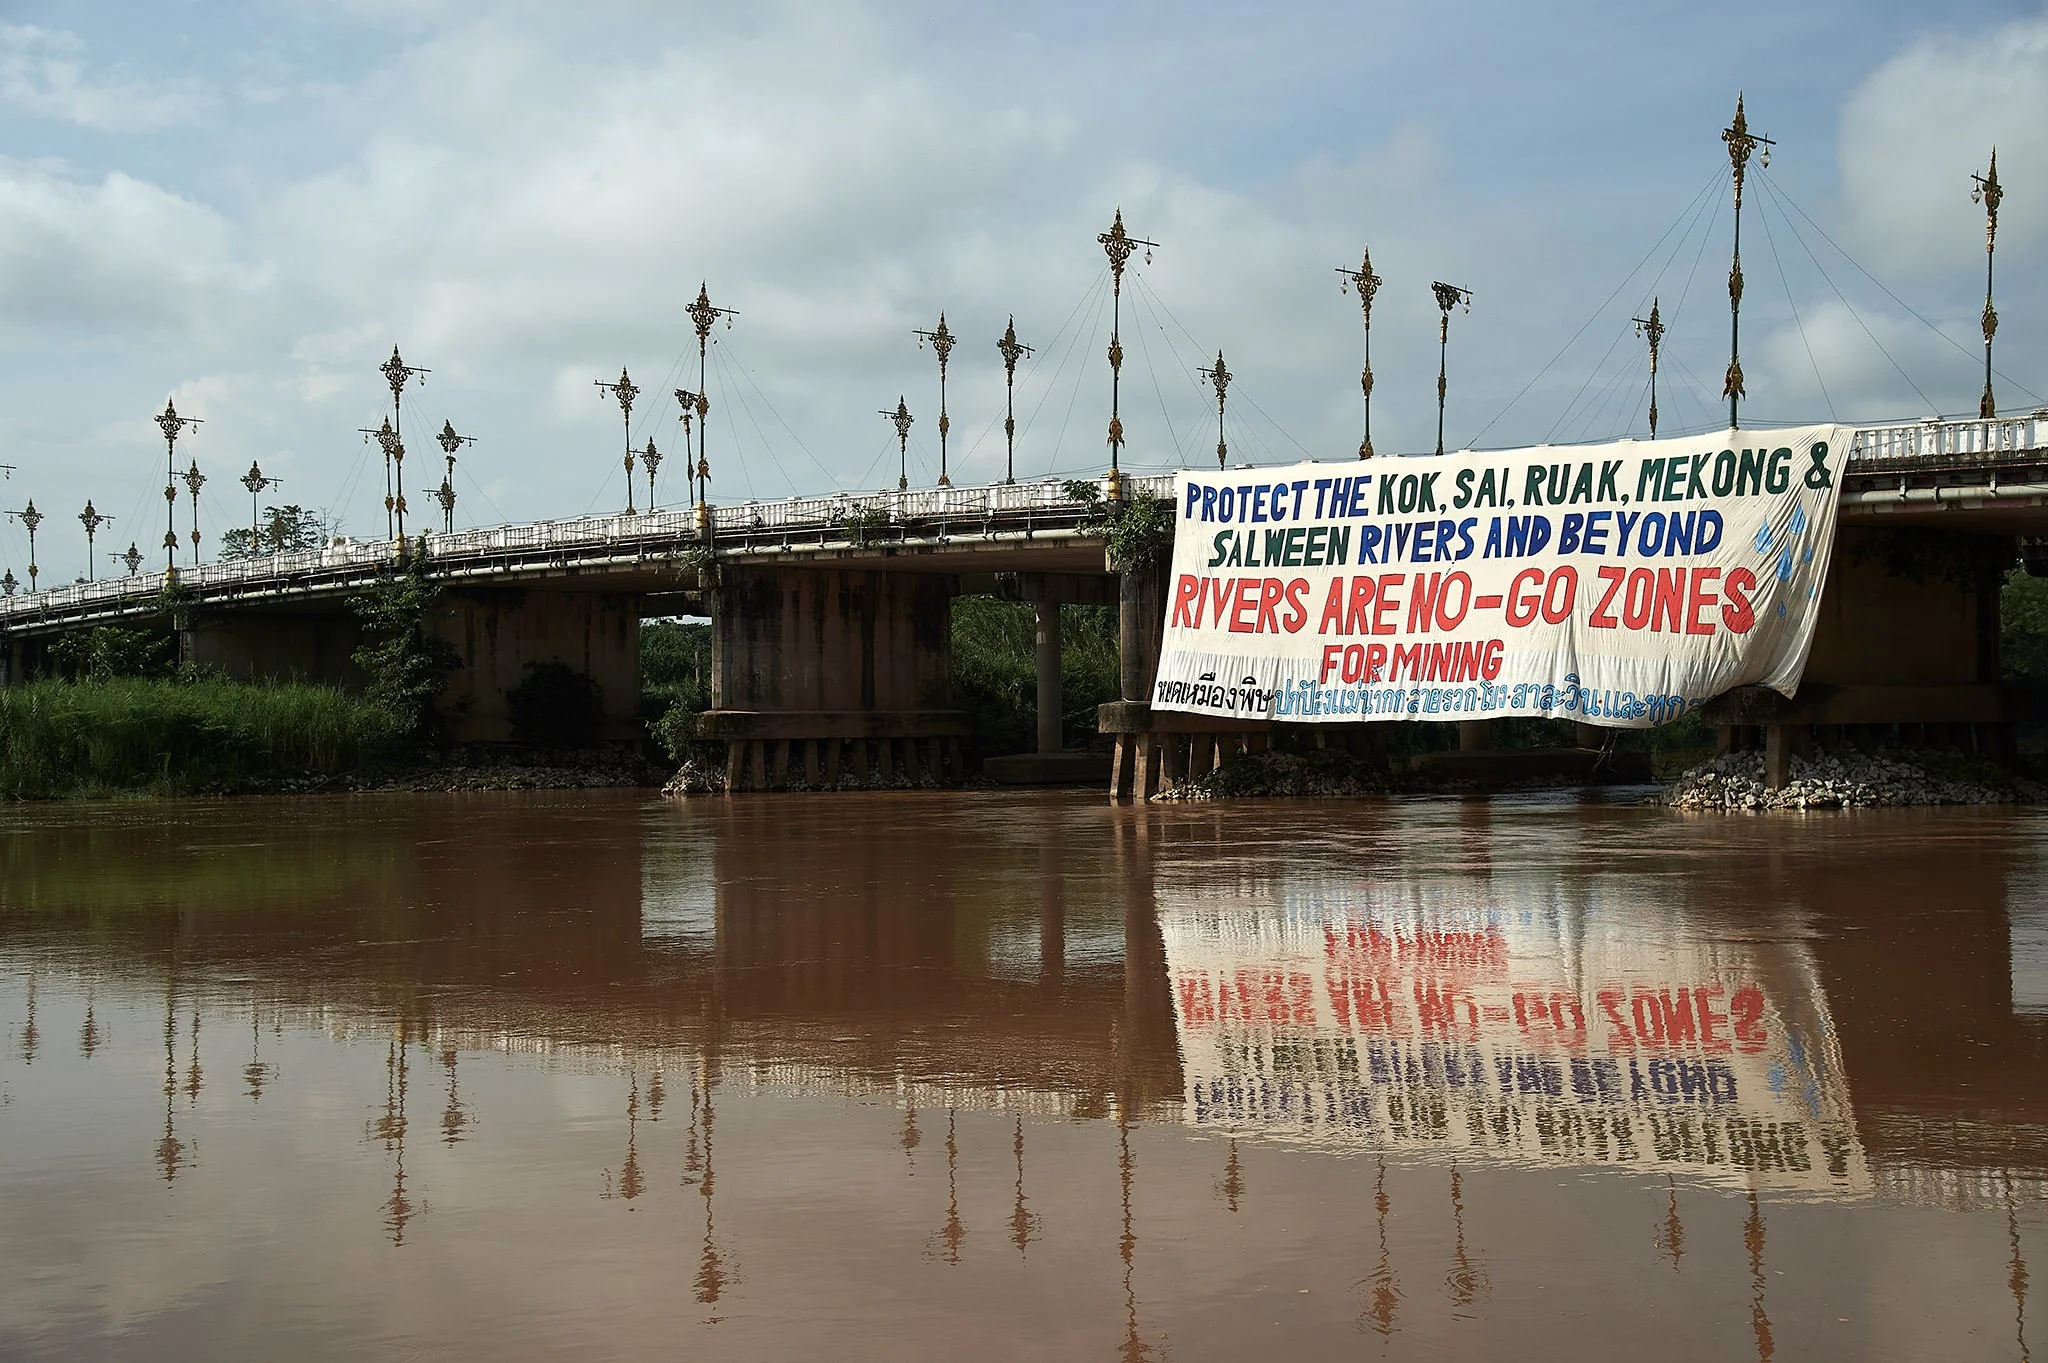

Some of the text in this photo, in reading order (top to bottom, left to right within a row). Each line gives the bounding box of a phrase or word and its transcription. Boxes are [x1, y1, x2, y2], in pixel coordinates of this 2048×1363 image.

[1185, 441, 1832, 523] PROTECT THE KOK, SAI, RUAK, MEKONG &
[1208, 509, 1723, 567] SALWEEN RIVERS AND BEYOND
[1171, 565, 1756, 635] RIVERS ARE NO-GO ZONES
[1320, 639, 1505, 685] FOR MINING
